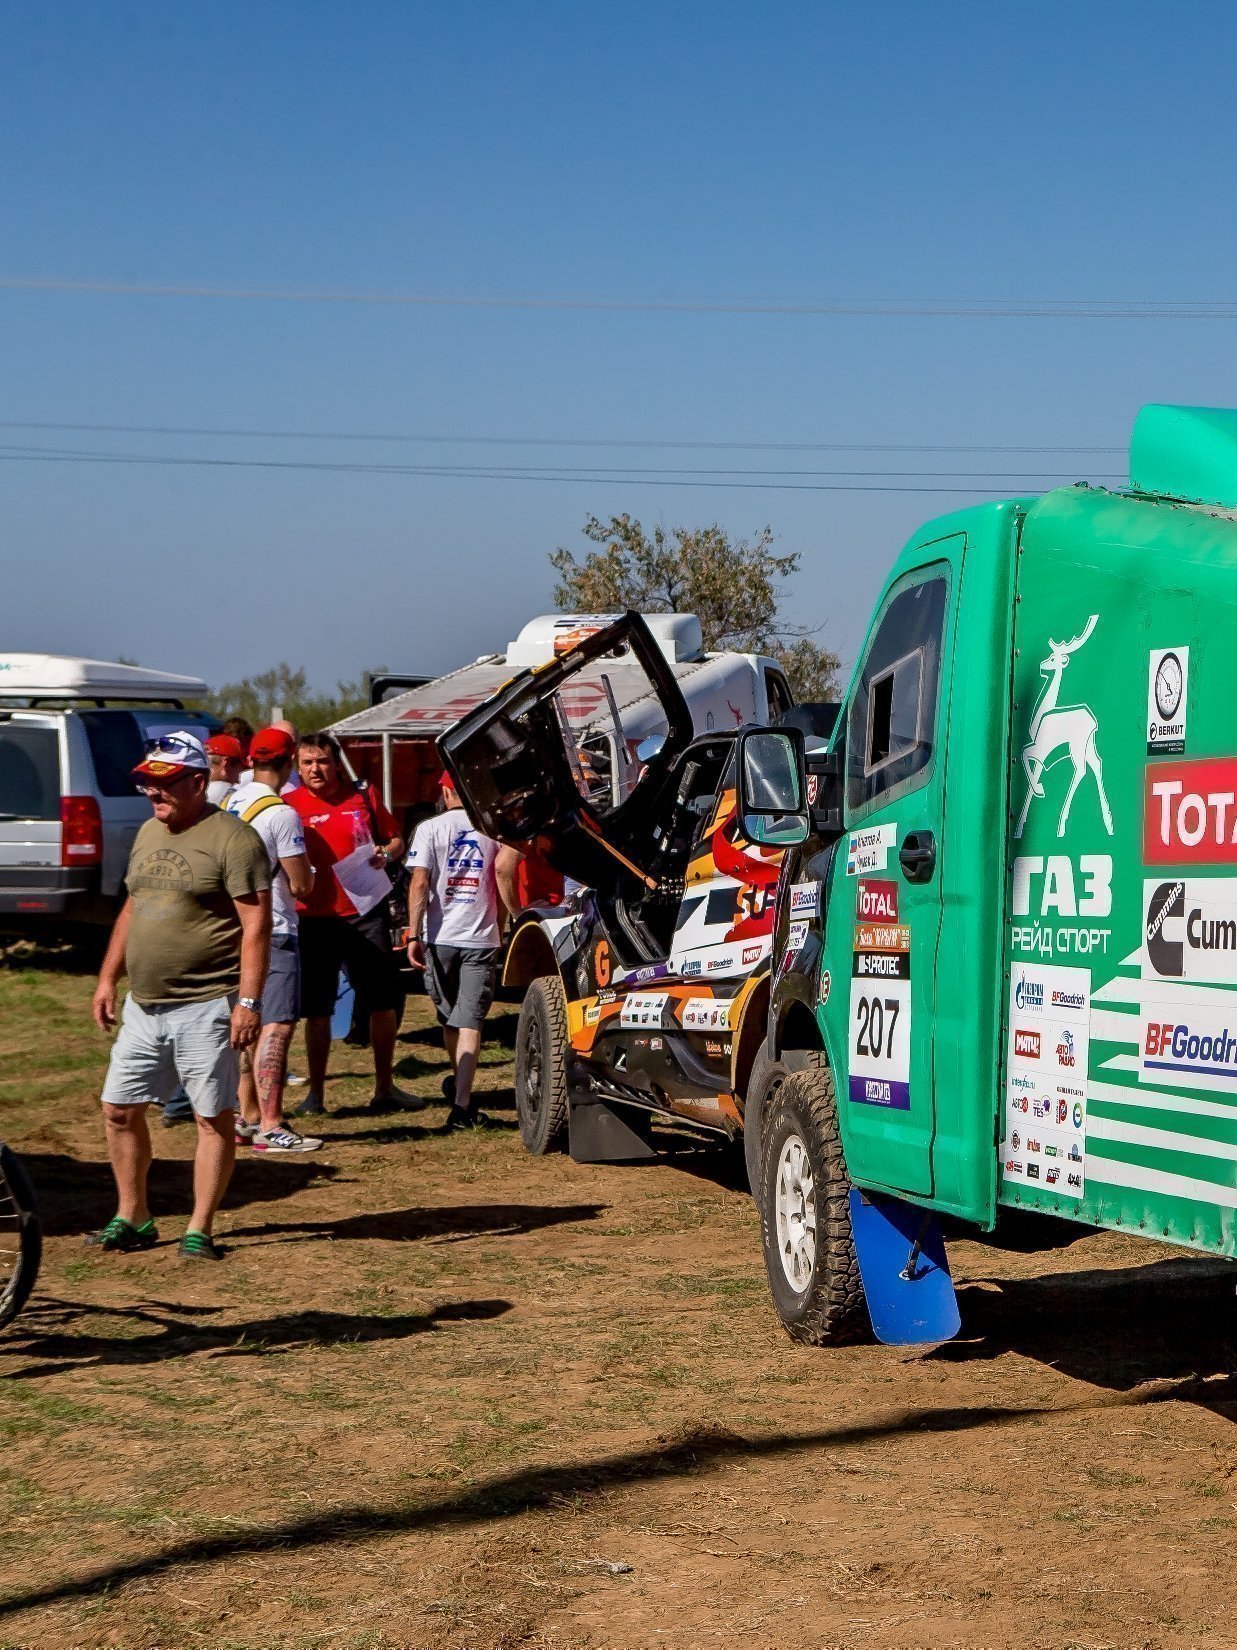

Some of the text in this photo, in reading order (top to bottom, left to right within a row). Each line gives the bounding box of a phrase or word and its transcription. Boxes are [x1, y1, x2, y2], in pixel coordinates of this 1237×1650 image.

[1158, 724, 1184, 736] BERKUT
[448, 858, 484, 868] ГАЗ
[1012, 855, 1113, 918] ГАЗ
[858, 885, 897, 917] TOTAL
[1146, 881, 1183, 941] Cummins
[1011, 920, 1112, 958] РЕЙД СПОРТ
[707, 959, 734, 969] BFGoodrich
[862, 955, 900, 975] SUPROTEC
[1051, 990, 1085, 1006] BFGoodrich
[856, 996, 900, 1059] 207
